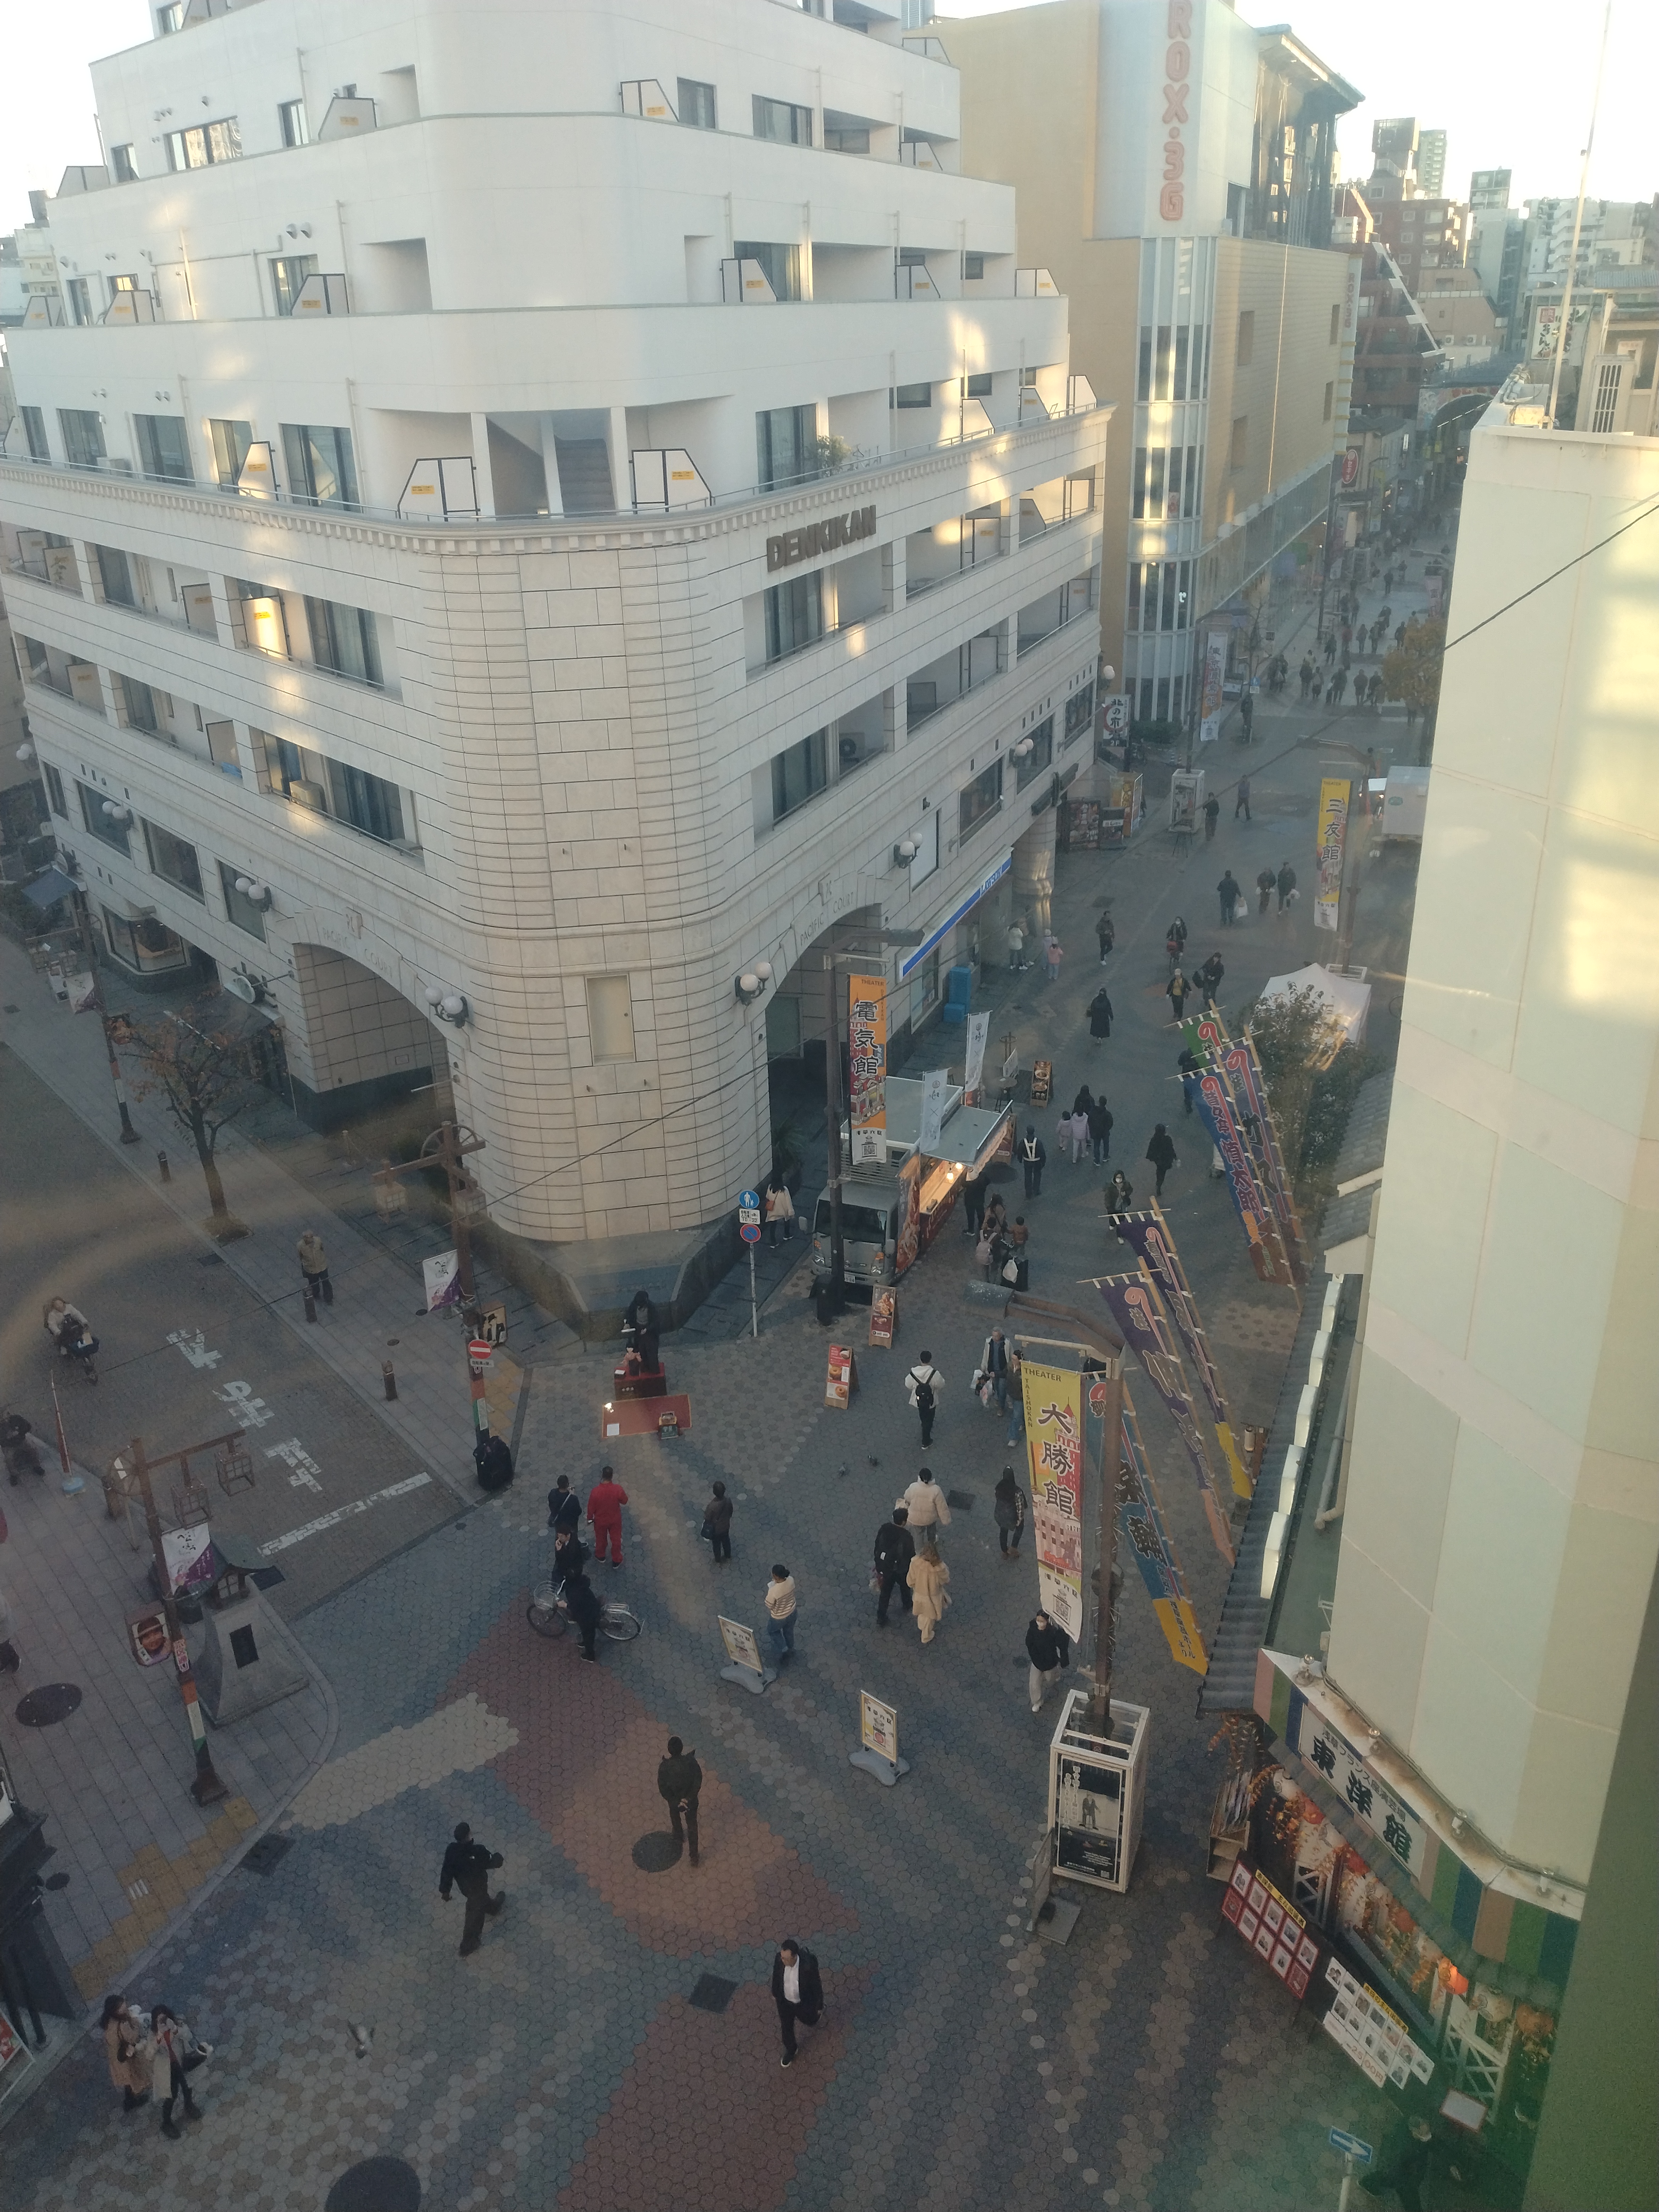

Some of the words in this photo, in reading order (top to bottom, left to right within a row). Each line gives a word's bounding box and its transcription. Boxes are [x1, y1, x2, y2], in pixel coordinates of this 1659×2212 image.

[766, 505, 877, 572] DENKIKAN
[1321, 798, 1343, 860] 三友館
[800, 912, 824, 946] PACIFIC
[833, 892, 854, 914] COURT
[364, 948, 393, 978] COURT
[854, 1000, 879, 1075] 電気館
[1024, 1367, 1061, 1382] THEATER
[1038, 1403, 1074, 1515] 大勝館
[1311, 1735, 1412, 1864] 東洋館
